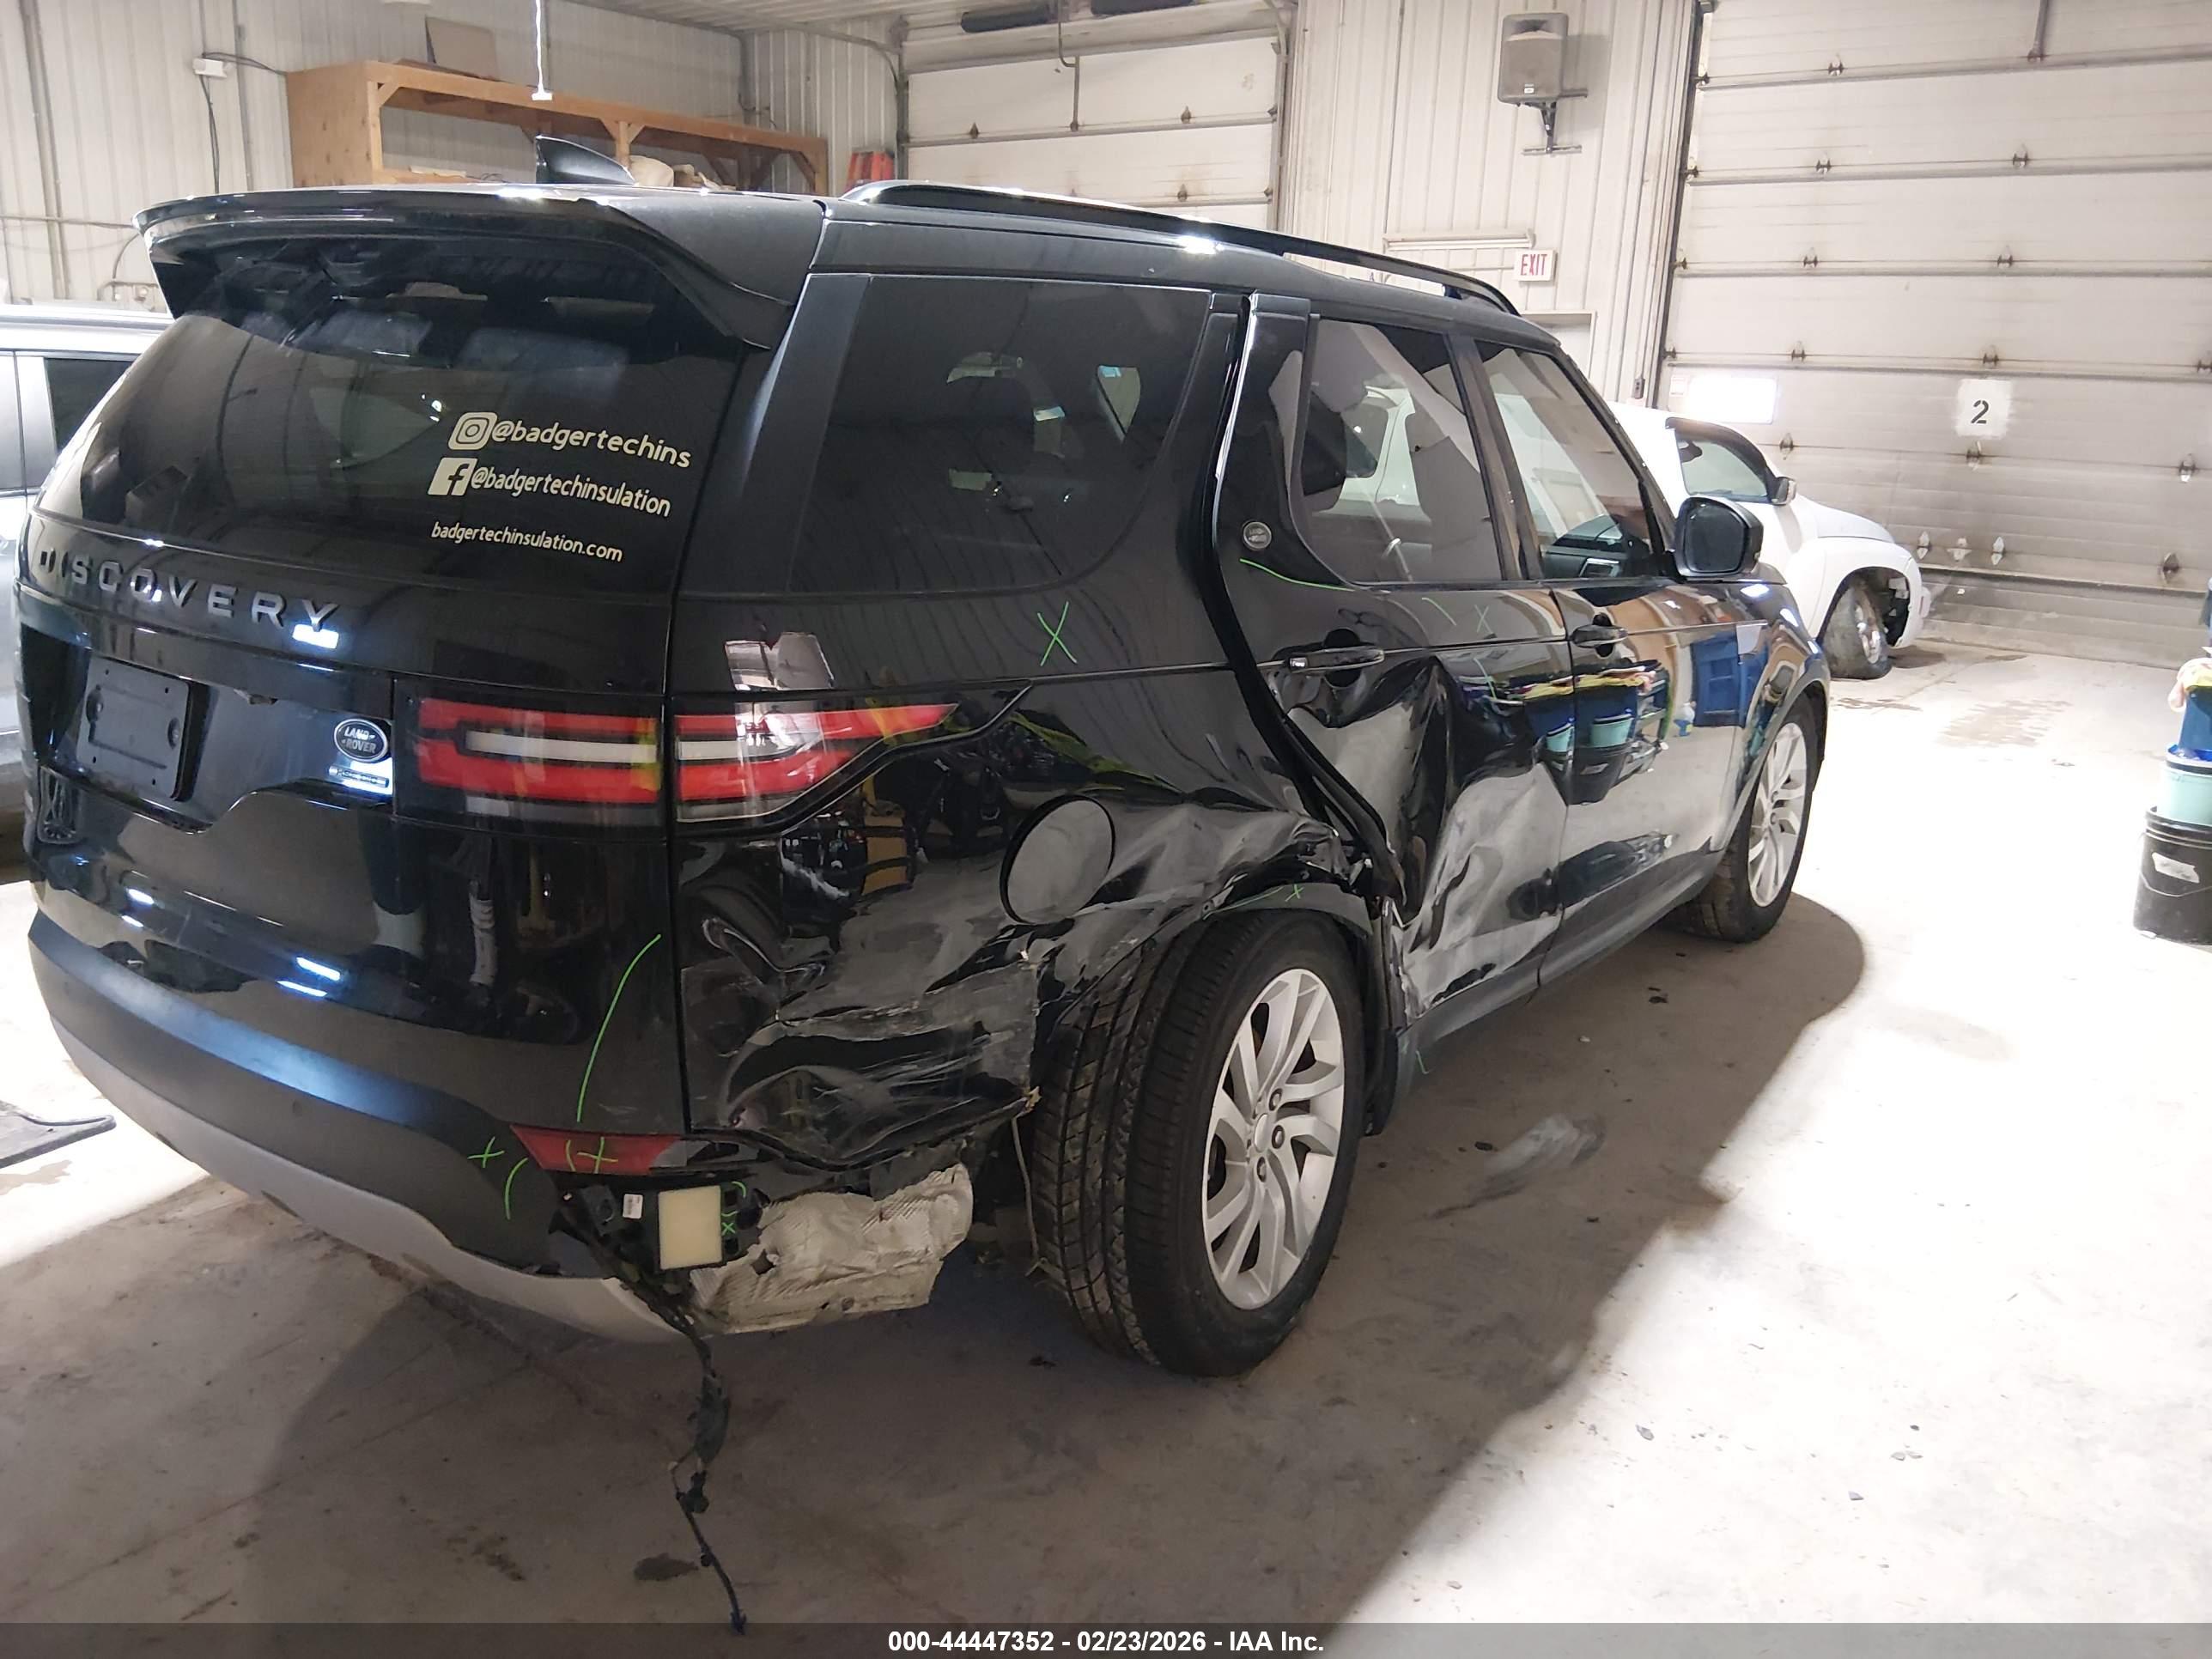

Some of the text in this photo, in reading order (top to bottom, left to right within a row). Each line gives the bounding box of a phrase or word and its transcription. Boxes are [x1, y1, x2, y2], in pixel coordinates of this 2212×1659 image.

[1520, 253, 1547, 276] EXIT
[1971, 399, 1990, 424] 2
[491, 420, 692, 469] @badgertechins
[471, 467, 672, 517] @badgertechinsulation
[431, 521, 624, 562] badgertechinsulation.com
[344, 726, 370, 740] LAND
[345, 738, 377, 754] ROVER
